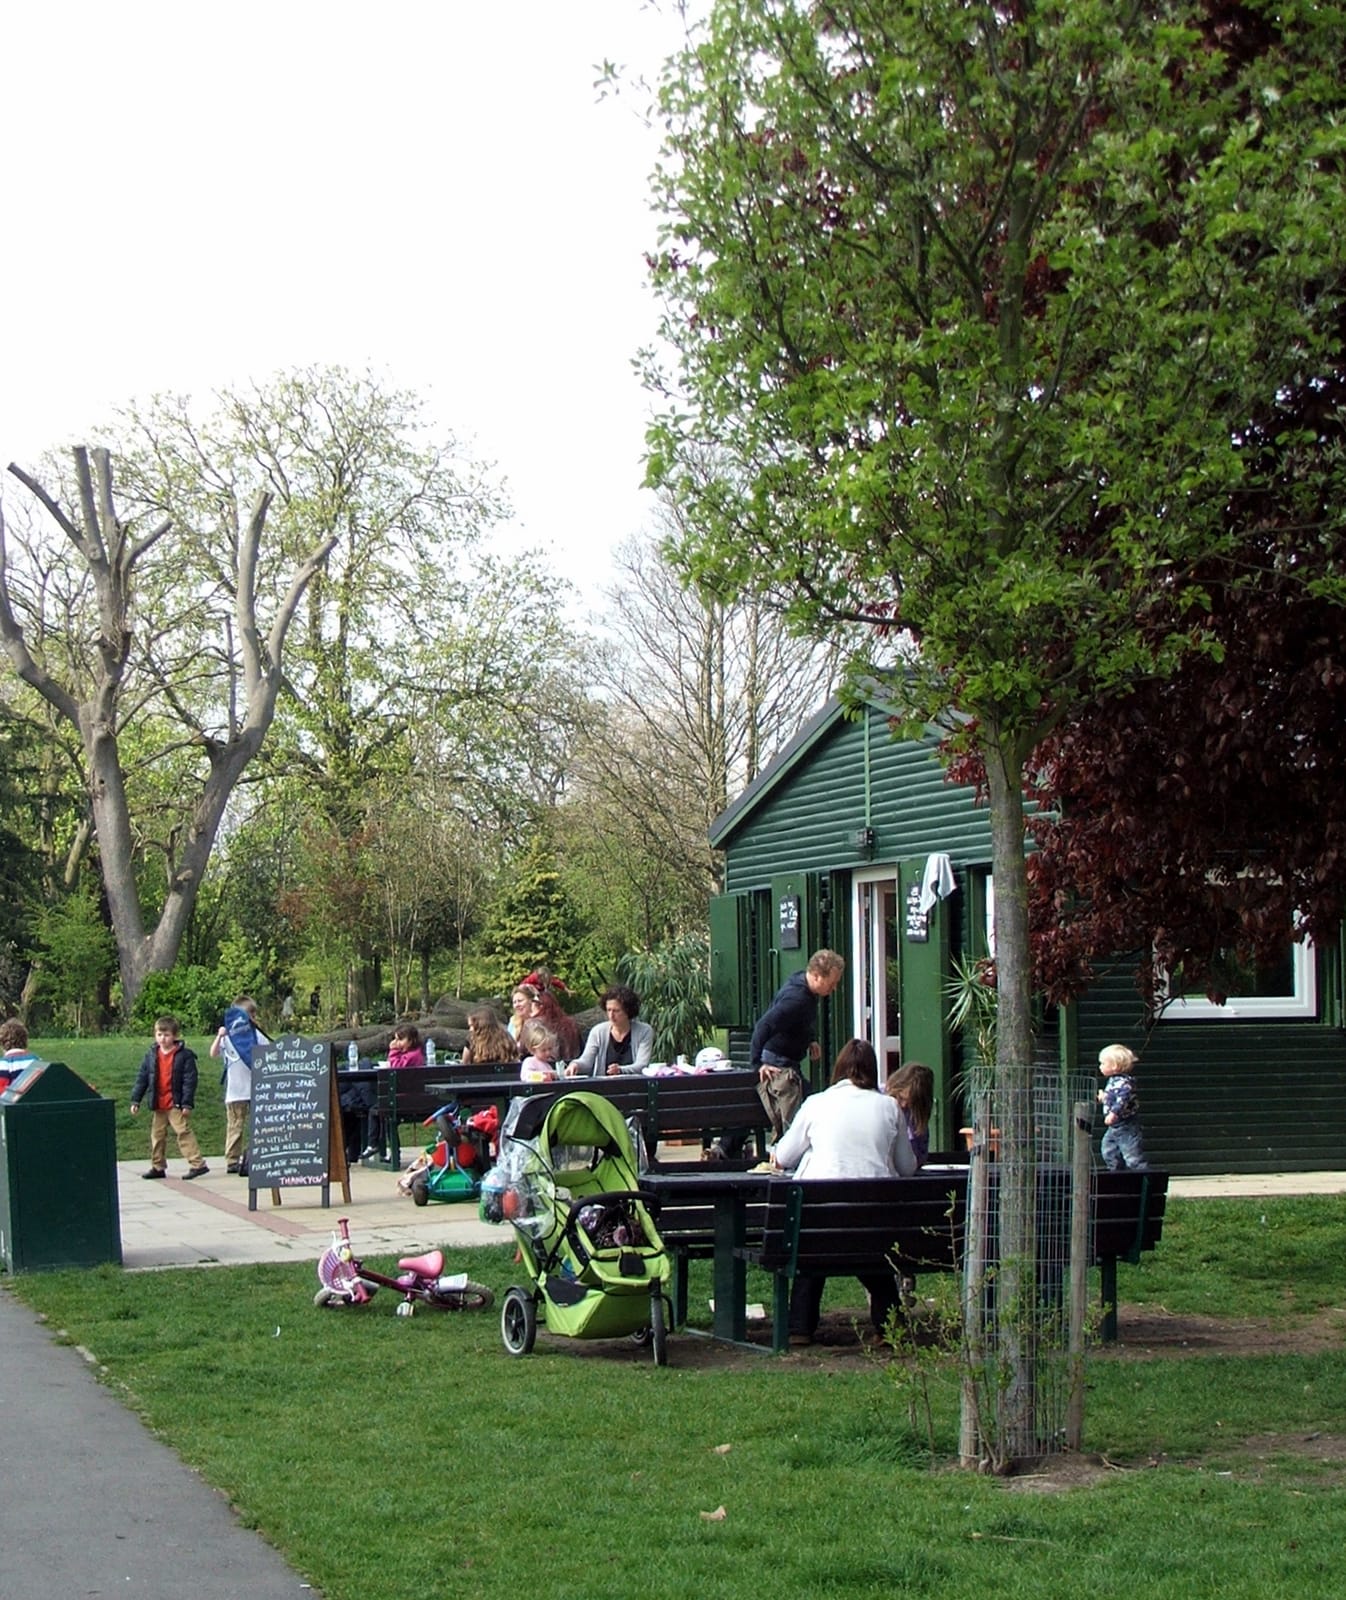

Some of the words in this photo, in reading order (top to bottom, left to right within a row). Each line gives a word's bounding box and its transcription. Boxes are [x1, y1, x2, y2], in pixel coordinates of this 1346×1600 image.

[266, 1052, 278, 1062] WE
[284, 1050, 307, 1060] NEED
[267, 1057, 320, 1072] VOLUNTEERS!
[276, 1081, 291, 1090] YOU
[296, 1079, 317, 1088] SPARE
[255, 1116, 260, 1124] A
